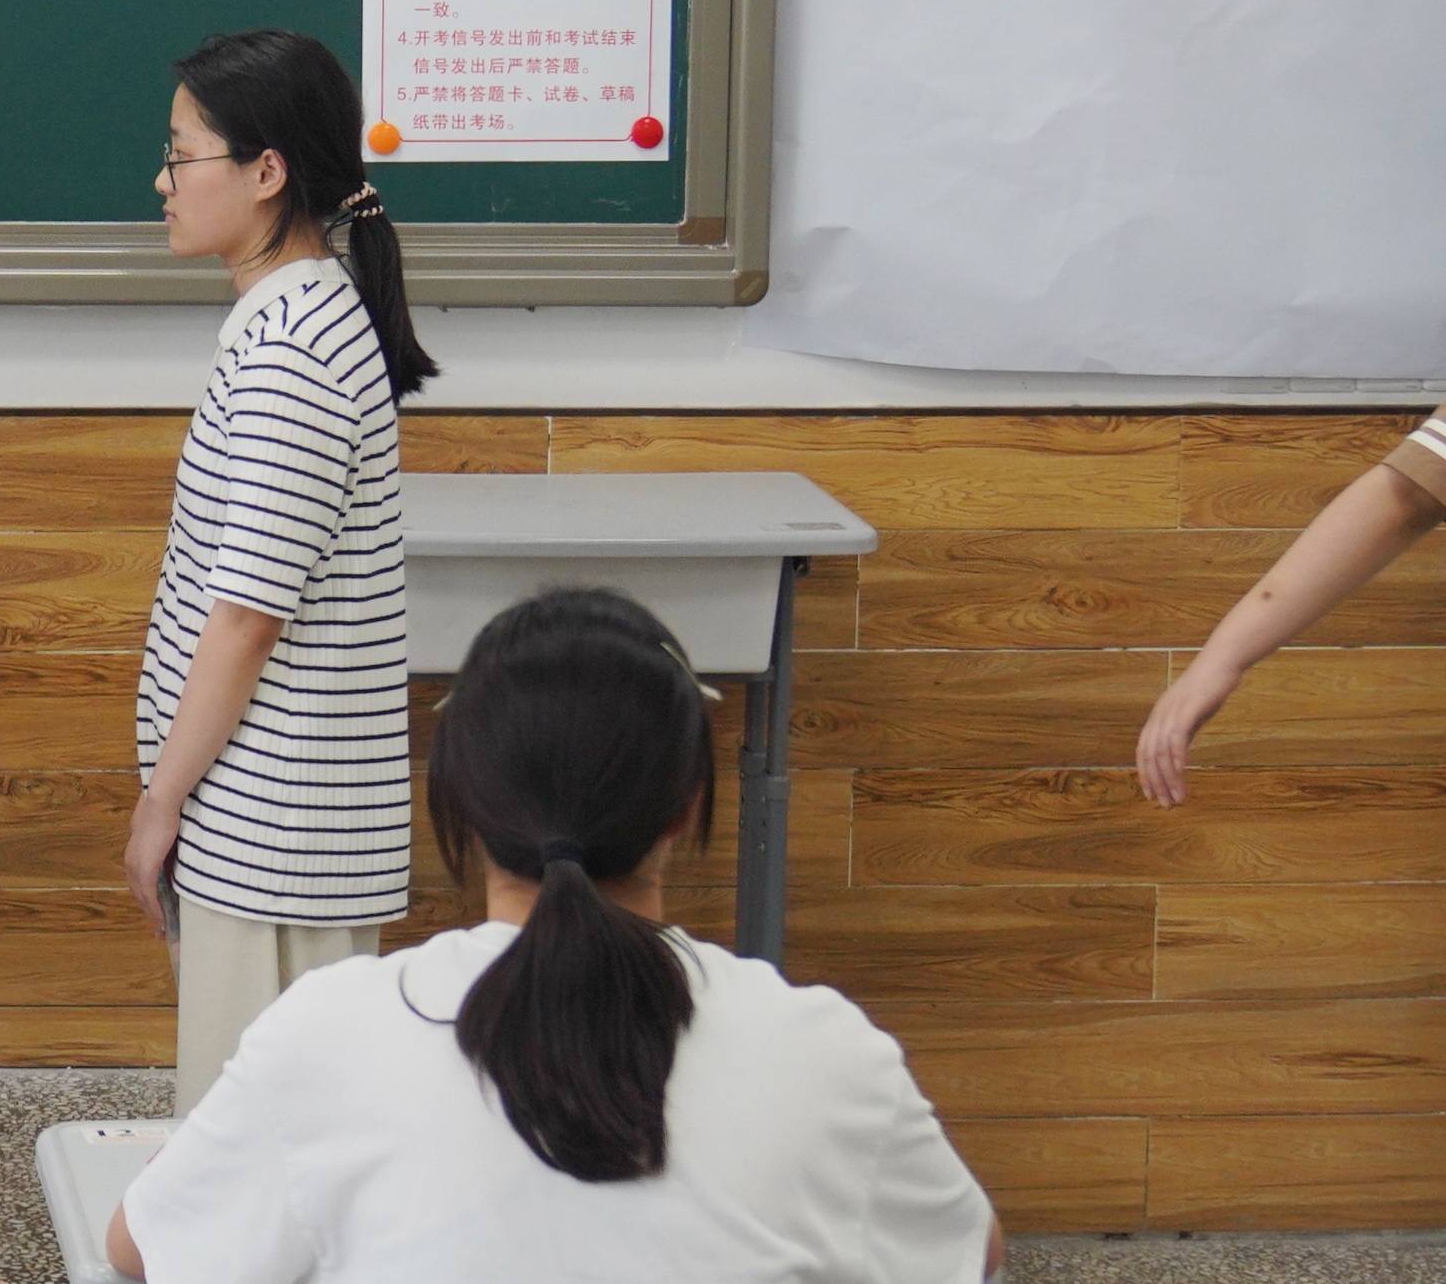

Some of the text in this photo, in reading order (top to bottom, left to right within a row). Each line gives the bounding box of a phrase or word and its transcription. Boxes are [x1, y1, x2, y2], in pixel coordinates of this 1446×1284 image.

[414, 2, 460, 18] 一致。
[413, 57, 591, 75] 信号发出后严禁答题。
[413, 114, 516, 131] 纸带出考场。
